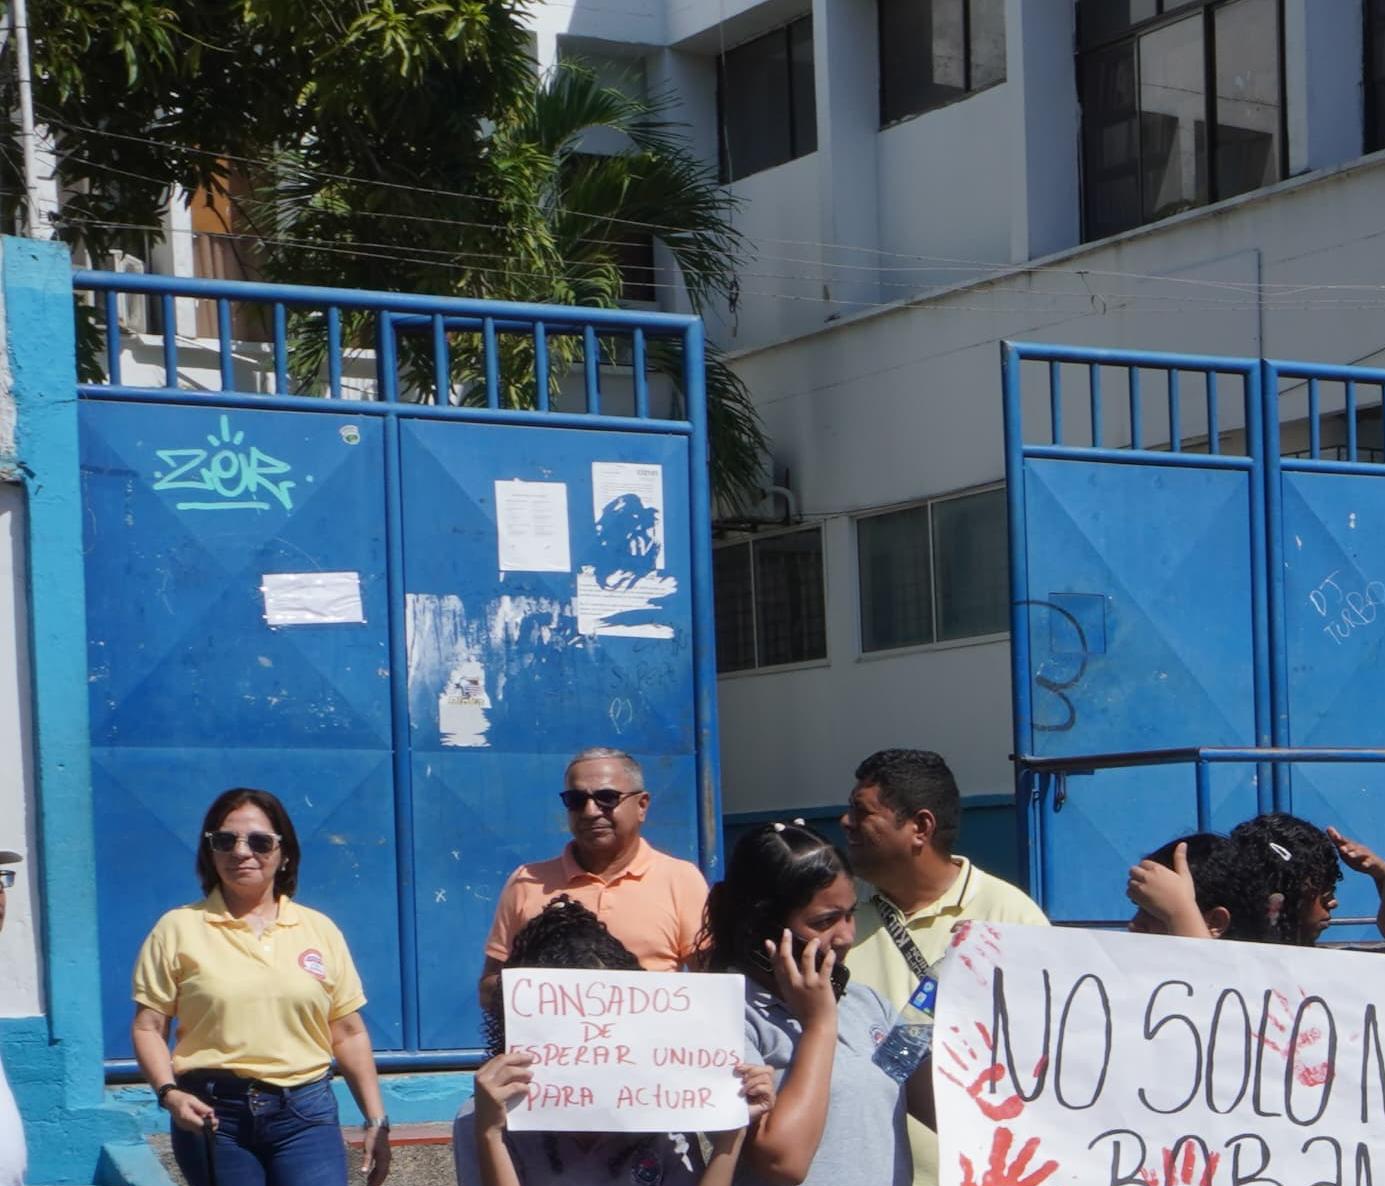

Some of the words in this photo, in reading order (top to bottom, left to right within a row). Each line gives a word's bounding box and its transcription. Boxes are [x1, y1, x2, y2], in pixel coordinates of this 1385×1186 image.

[511, 977, 691, 1018] CANSADOS
[580, 1020, 617, 1043] DE
[990, 966, 1112, 1109] NO
[1139, 980, 1336, 1126] SOLO
[653, 1048, 742, 1068] UNIDOS
[525, 1083, 593, 1112] PARA
